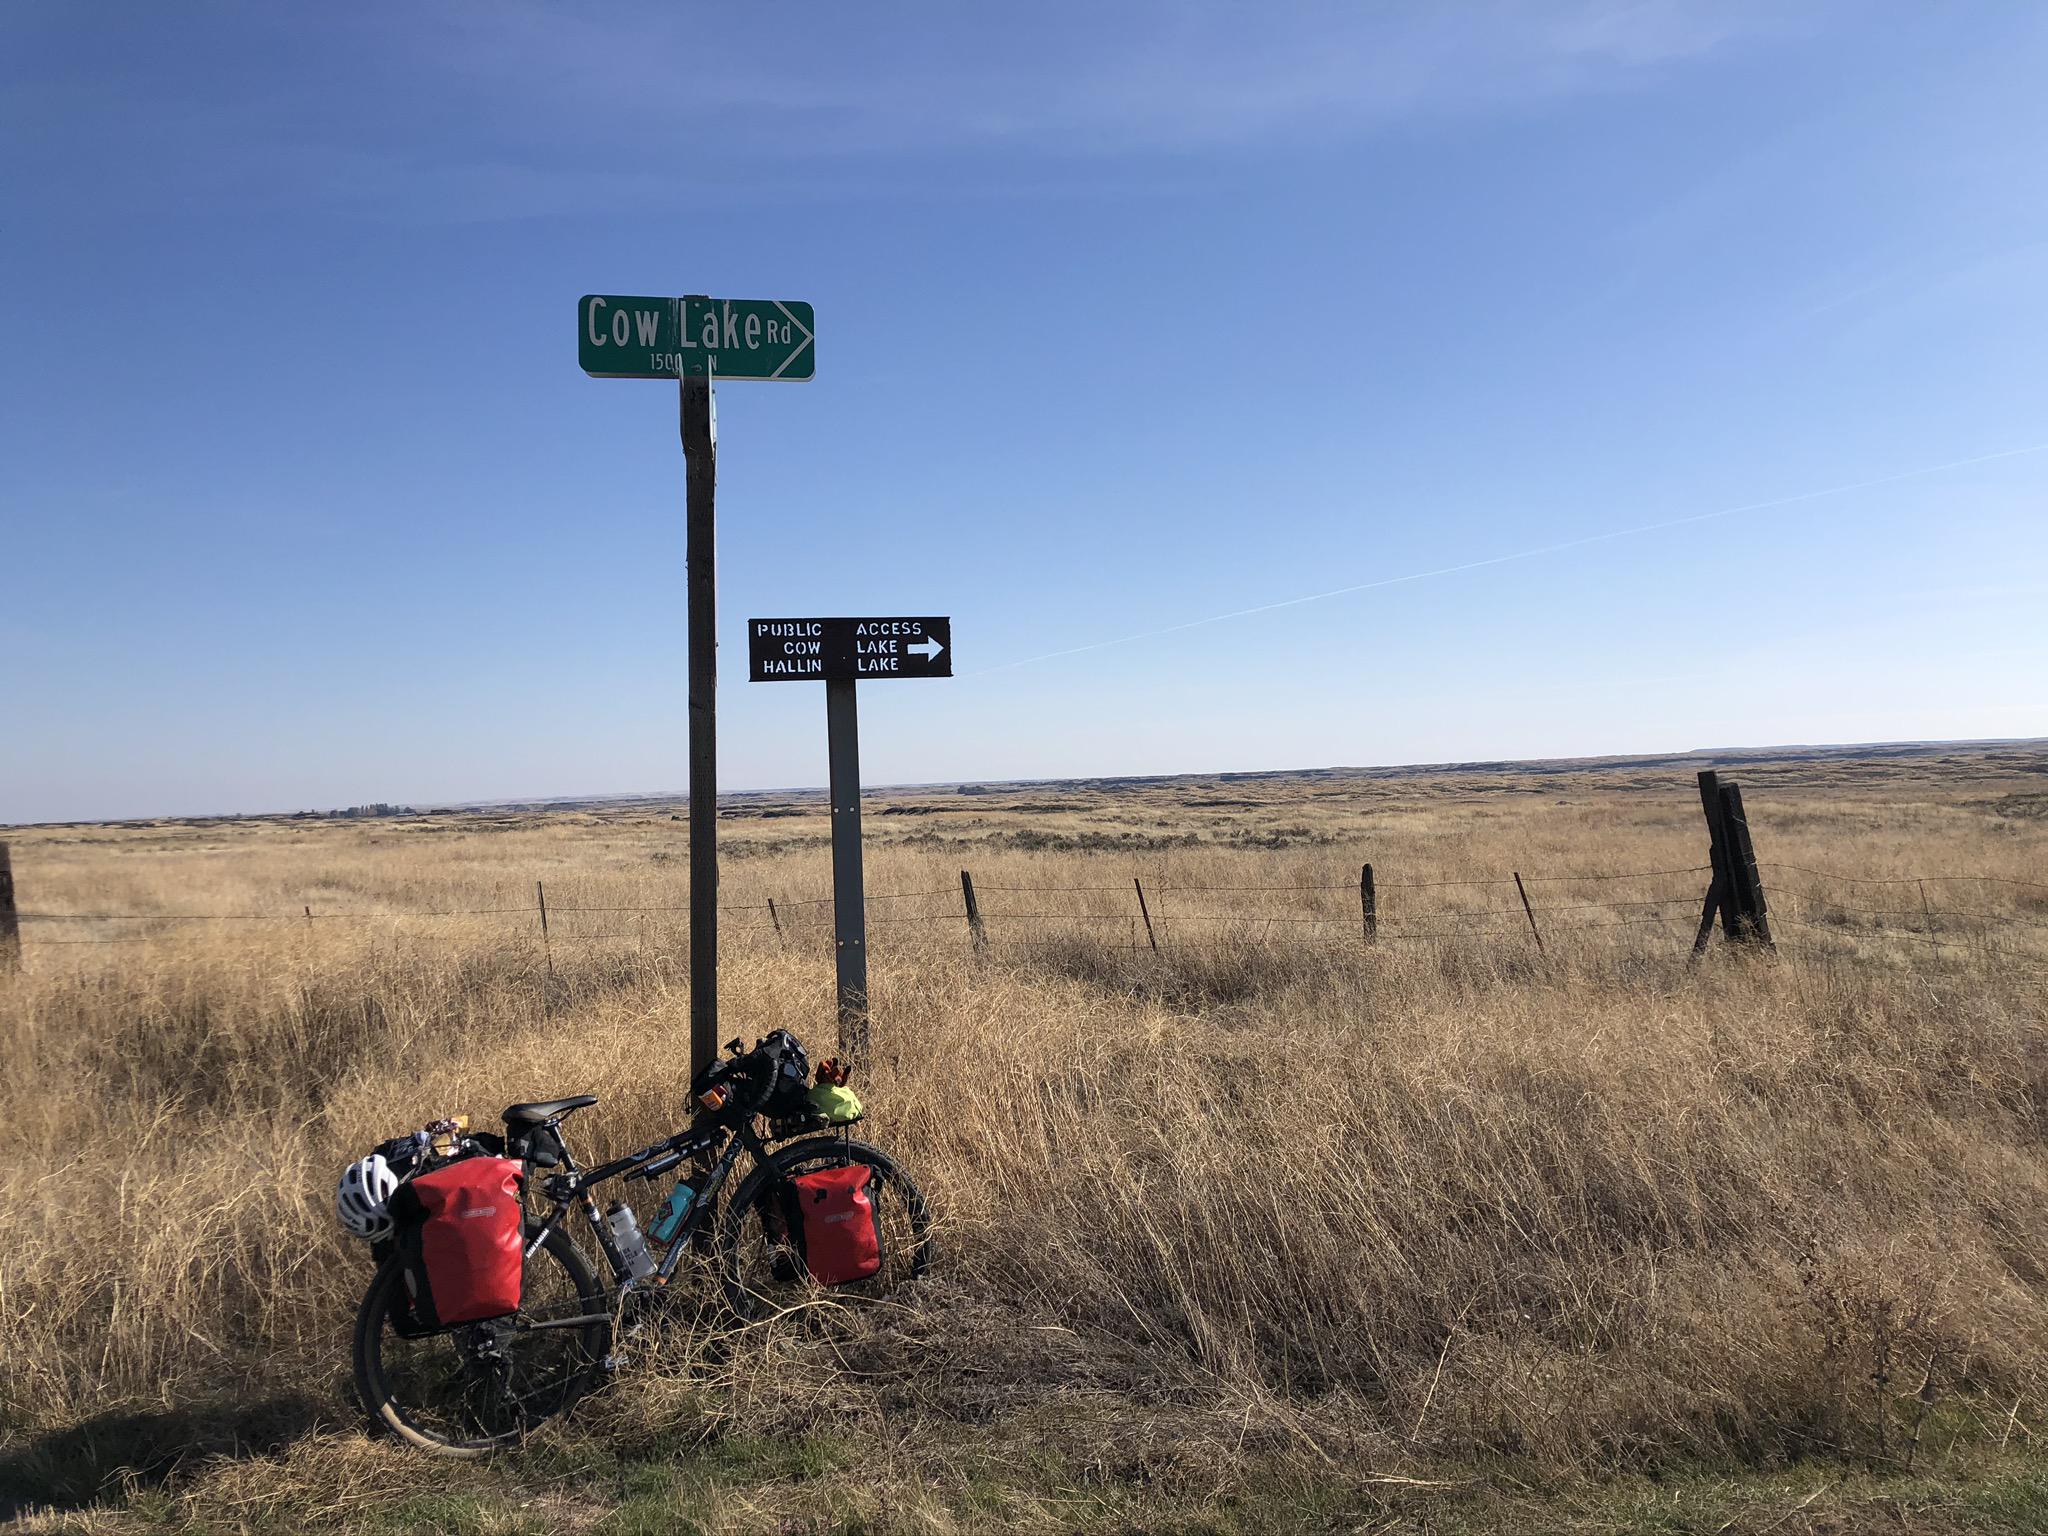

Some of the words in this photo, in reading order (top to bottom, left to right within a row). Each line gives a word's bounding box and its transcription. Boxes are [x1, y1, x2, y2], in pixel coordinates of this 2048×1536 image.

[588, 297, 659, 347] Cow
[680, 300, 761, 350] Lake
[767, 320, 791, 344] Rd
[757, 623, 822, 637] PUBLIC
[856, 622, 922, 635] ACCESS
[784, 641, 821, 654] COW
[856, 640, 898, 653] LAKE
[763, 659, 822, 673] HALLIN
[857, 658, 899, 671] LAKE
